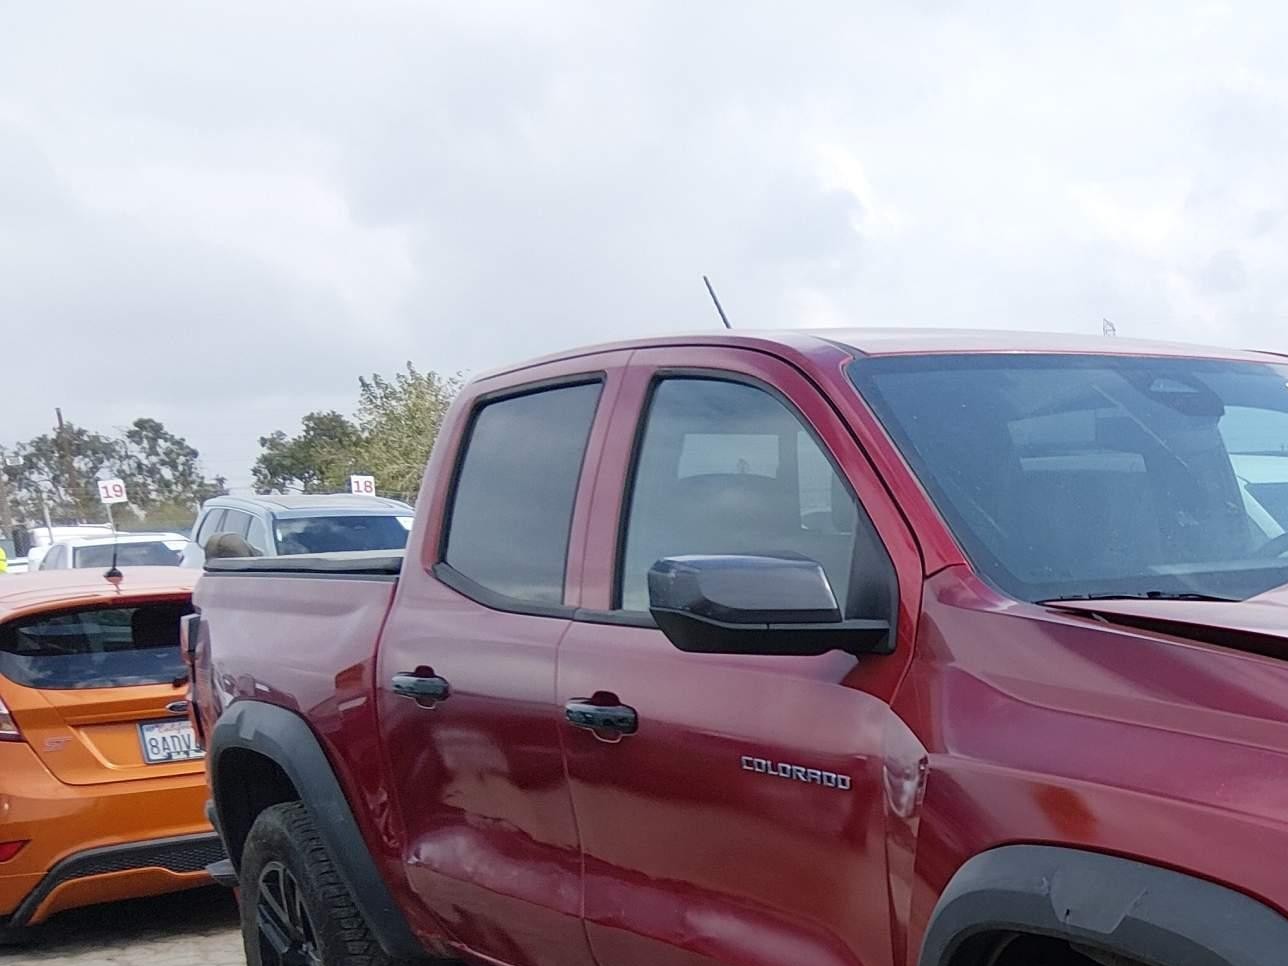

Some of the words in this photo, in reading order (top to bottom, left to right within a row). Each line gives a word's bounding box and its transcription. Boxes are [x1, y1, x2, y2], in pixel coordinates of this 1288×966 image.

[101, 484, 123, 498] 19
[353, 480, 373, 493] 18
[741, 756, 852, 790] COLORADO
